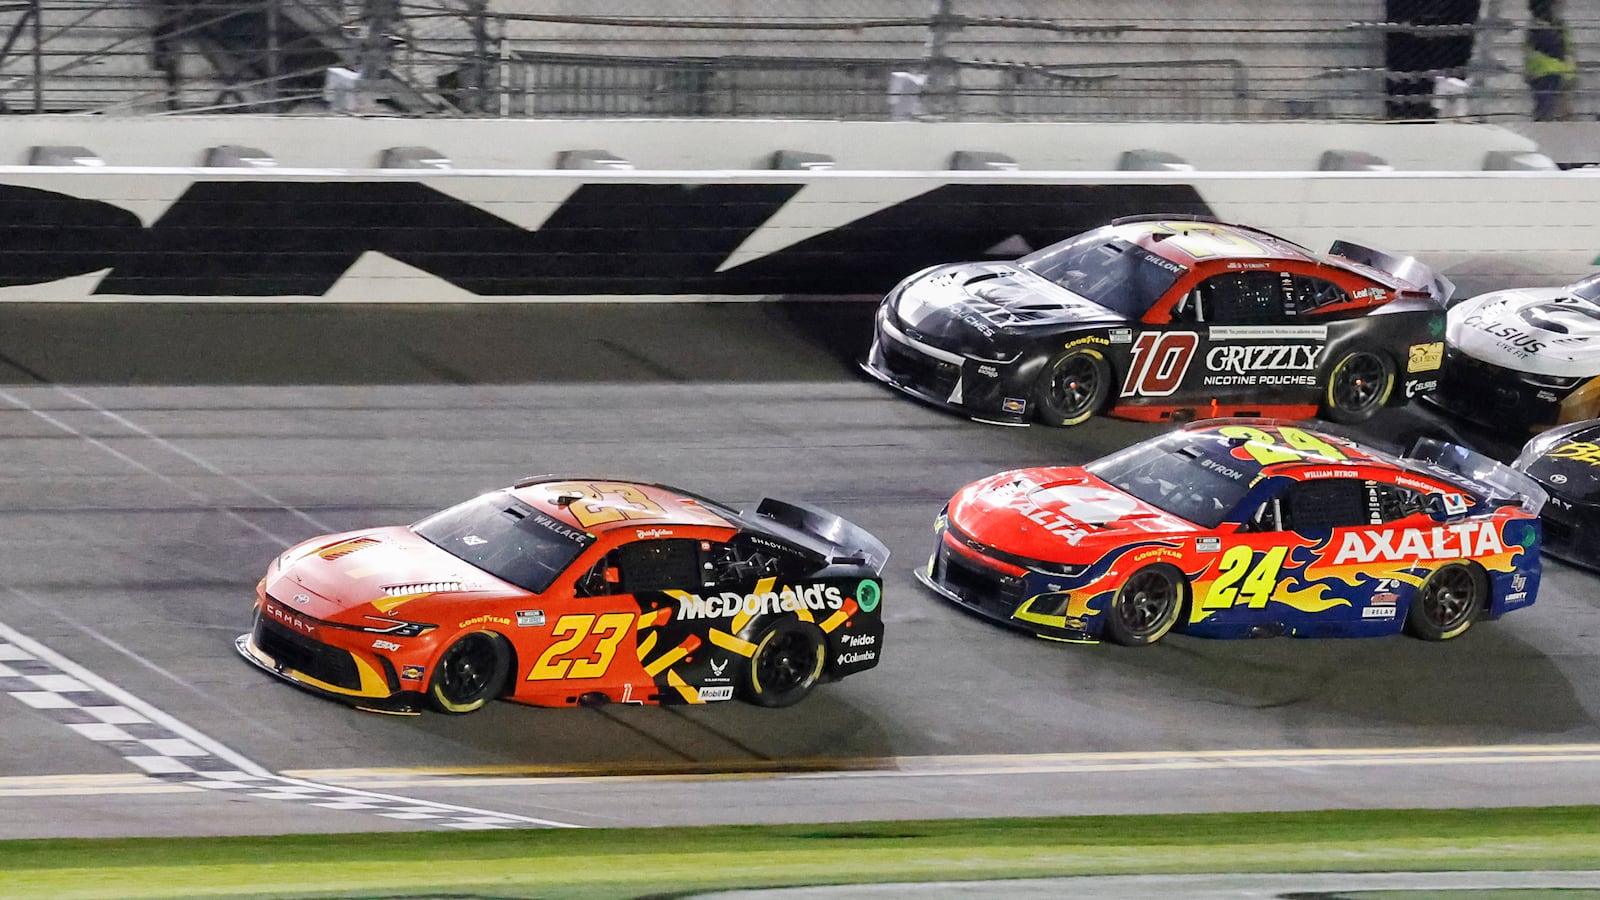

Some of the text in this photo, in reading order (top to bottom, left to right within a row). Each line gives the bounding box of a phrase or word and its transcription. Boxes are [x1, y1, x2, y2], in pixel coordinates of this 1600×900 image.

[1145, 254, 1181, 273] DILLON
[1064, 335, 1110, 349] GOODYEAR
[1496, 341, 1529, 360] LIVE FIT
[1120, 331, 1200, 396] 10
[1206, 345, 1325, 375] GRIZZLY
[1204, 376, 1316, 385] NICOTINE POUCHES
[1218, 426, 1348, 466] 24
[1201, 459, 1243, 480] BYRON
[1304, 470, 1359, 478] WILLIAM BYRON
[546, 483, 669, 528] 23
[533, 514, 587, 544] WALLACE
[1333, 522, 1504, 565] AXALTA
[1134, 548, 1183, 562] GOODYEAR
[1202, 544, 1289, 609] 24
[677, 583, 842, 620] McDonald's
[266, 604, 315, 633] CAMRY
[458, 614, 511, 629] GOODYEAR
[527, 613, 635, 680] 23
[850, 633, 876, 647] leidos
[844, 650, 876, 664] Columbia
[701, 689, 721, 697] Mobil
